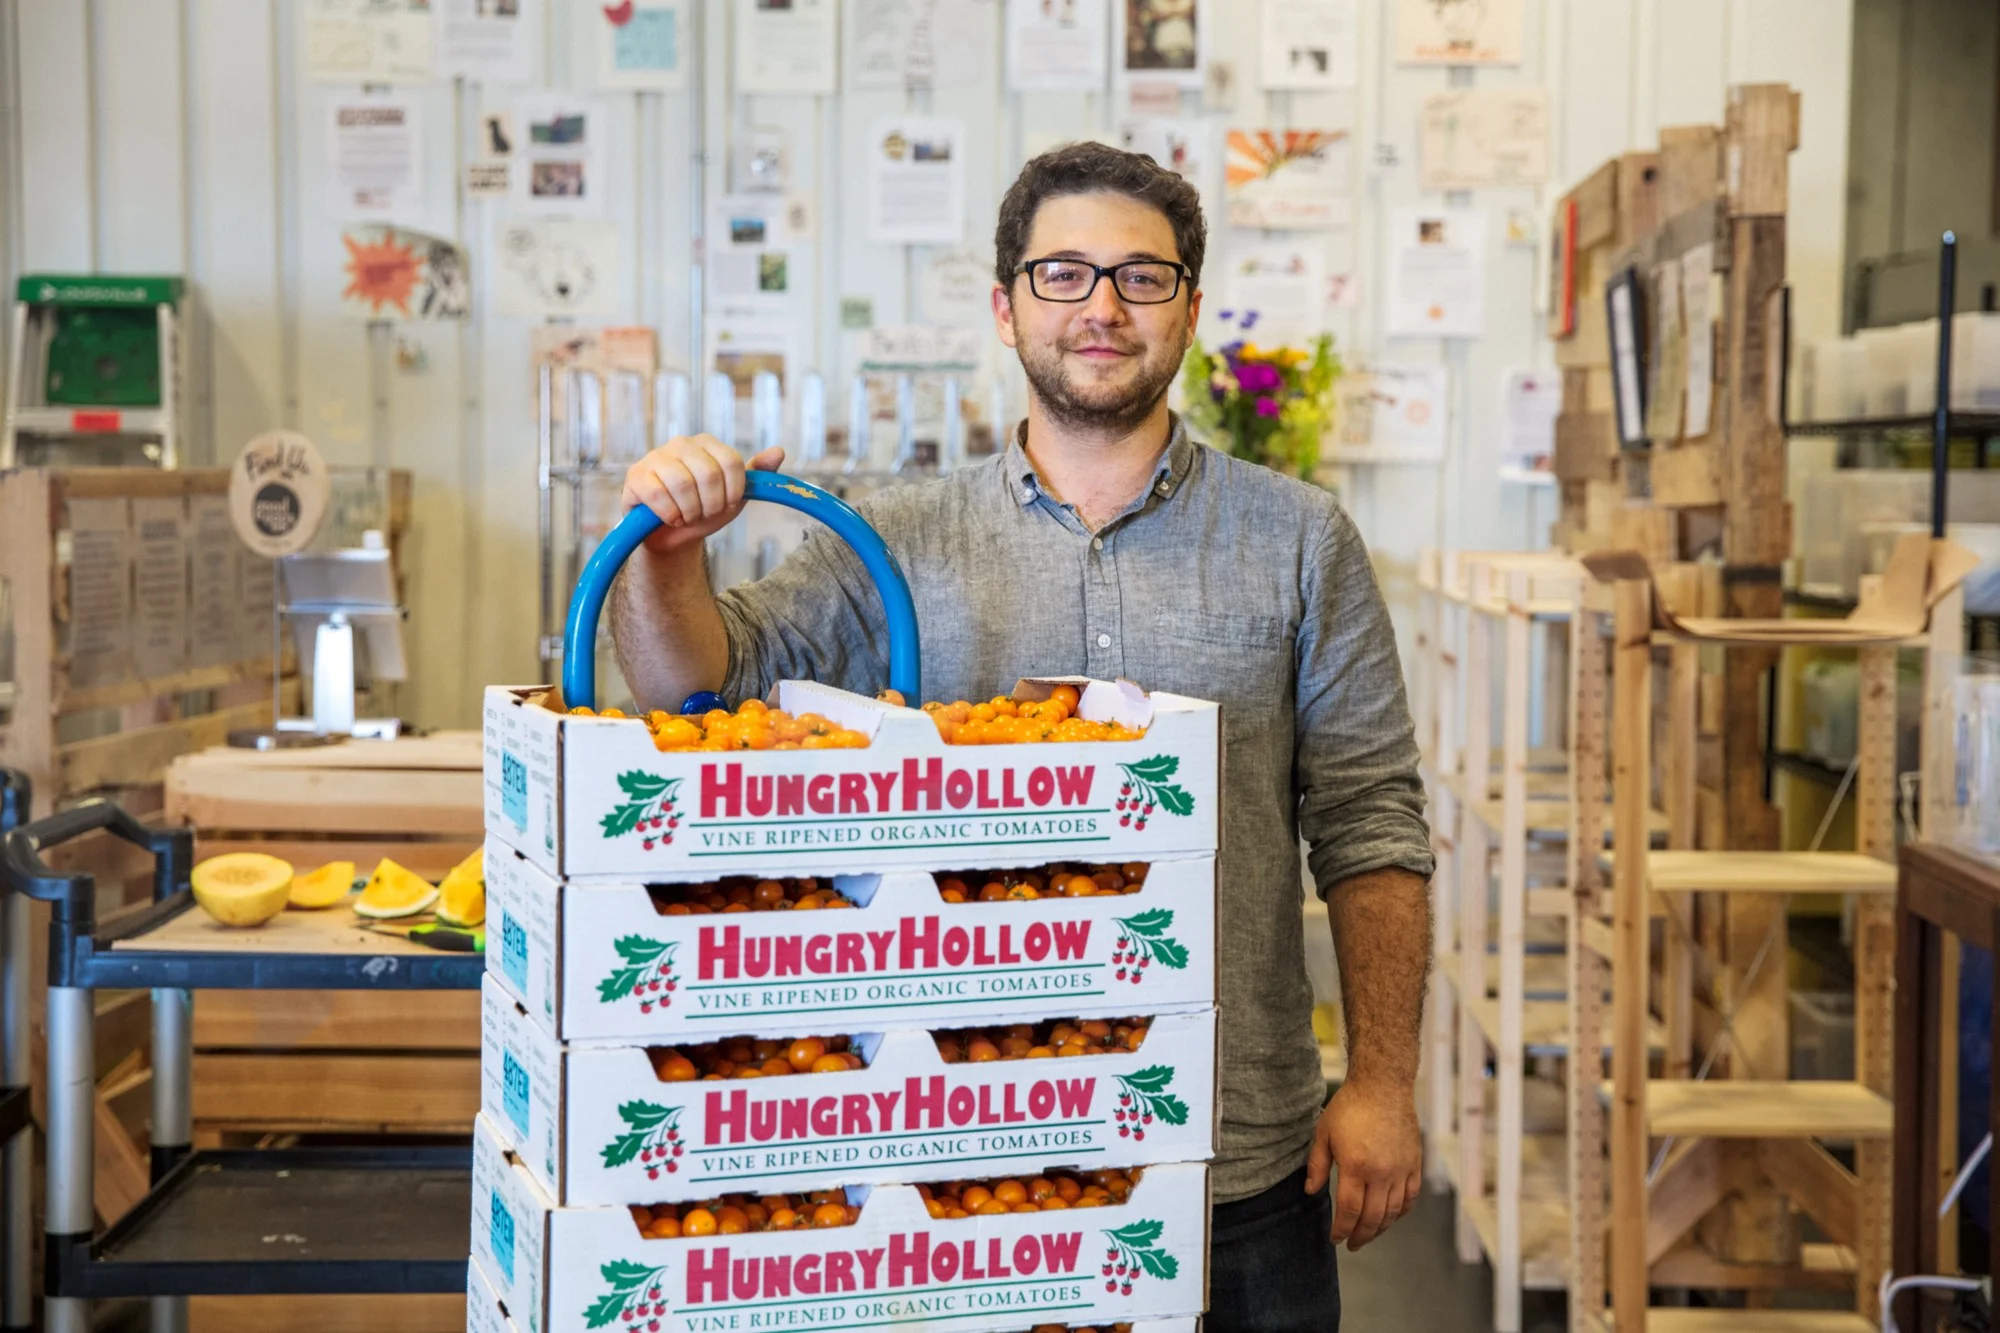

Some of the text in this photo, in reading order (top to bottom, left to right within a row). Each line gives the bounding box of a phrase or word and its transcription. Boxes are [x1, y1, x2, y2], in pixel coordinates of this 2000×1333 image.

[702, 818, 1098, 848] VINE RIPENED ORGANIC TOMATOES
[697, 973, 1093, 1010] VINE RIPENED ORGANIC TOMATOES
[703, 1129, 1093, 1171] VINE RIPENED ORGANIC TOMATOES
[686, 1286, 1082, 1333] VINE RIPENED ORGANIC TOMATOES
